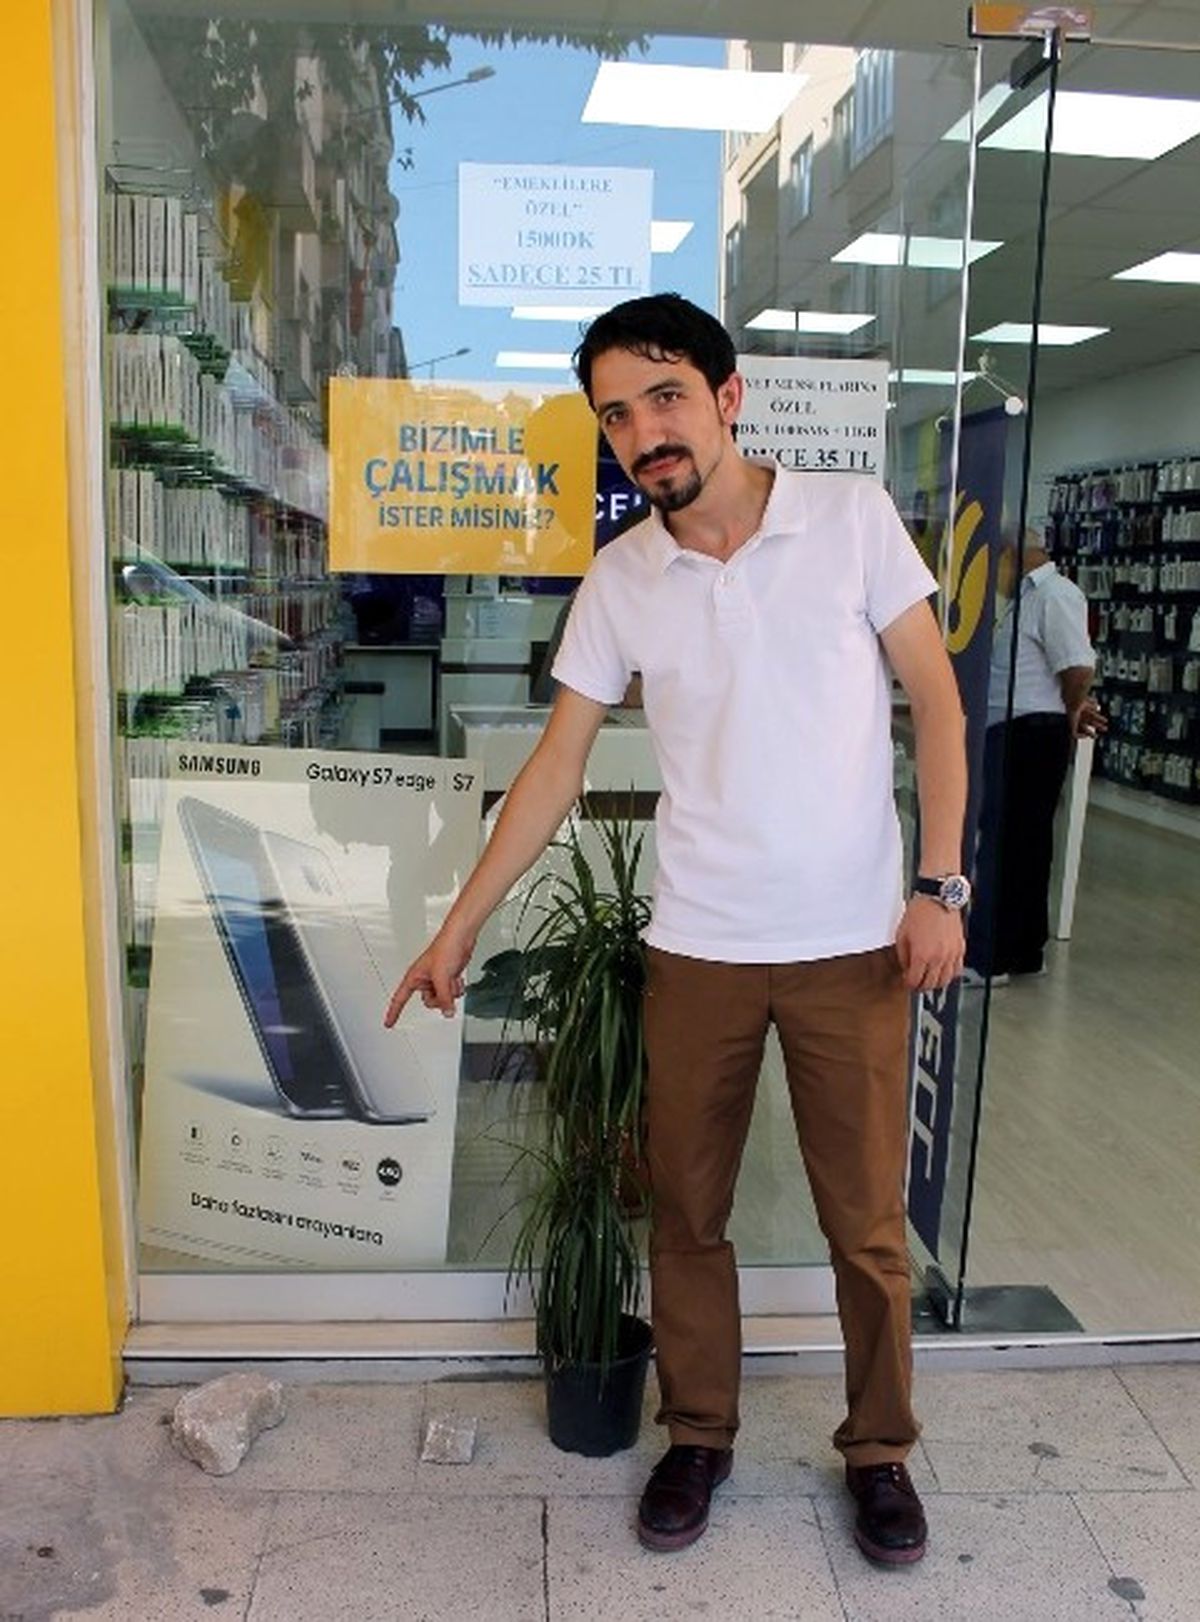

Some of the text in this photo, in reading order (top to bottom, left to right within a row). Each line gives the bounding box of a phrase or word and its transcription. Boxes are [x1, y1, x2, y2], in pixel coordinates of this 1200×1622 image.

[517, 231, 594, 249] 1500DK
[467, 264, 642, 286] SADECE 25 TL
[399, 424, 525, 455] BİZİMLE
[814, 447, 839, 468] 35
[845, 449, 877, 470] TL
[364, 458, 560, 499] ÇALIŞMAK
[379, 501, 443, 527] İSTER
[178, 754, 261, 776] SAMSUNG
[306, 763, 475, 792] Galaxy S7 edge S7
[191, 1191, 229, 1214] Daha
